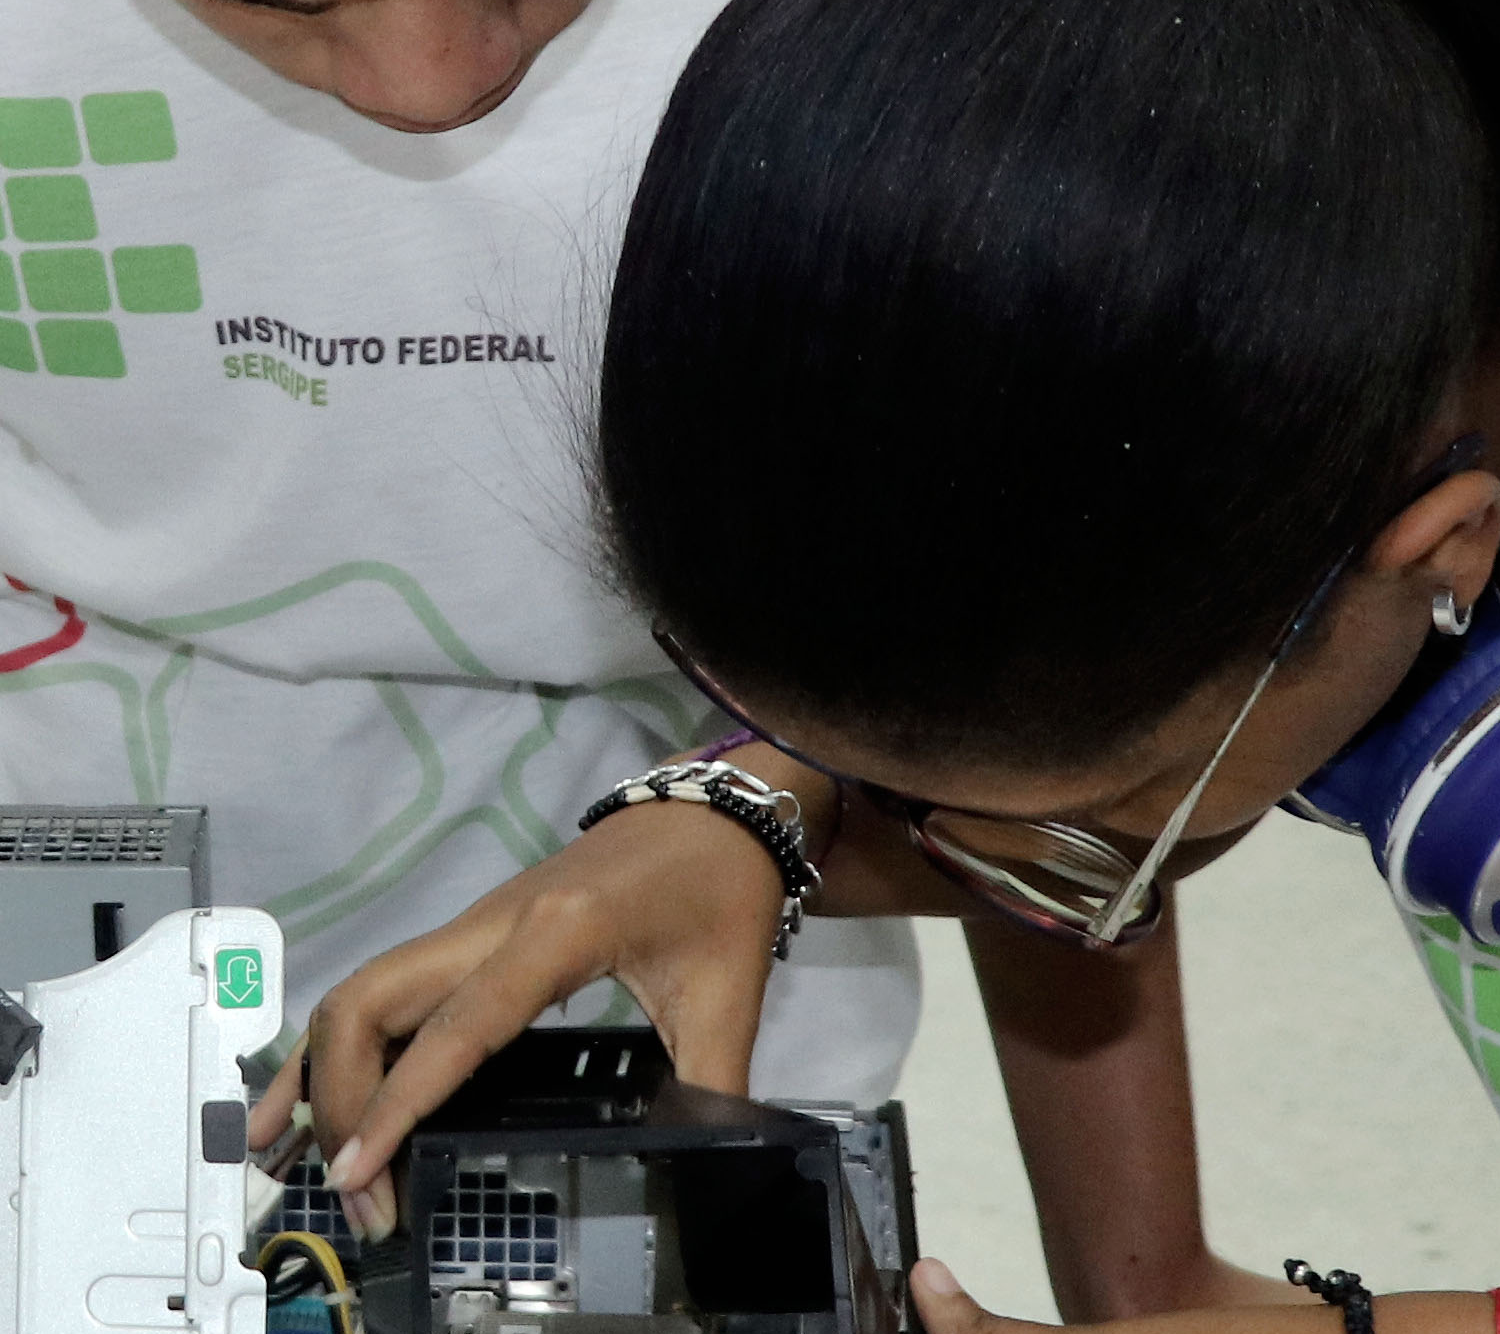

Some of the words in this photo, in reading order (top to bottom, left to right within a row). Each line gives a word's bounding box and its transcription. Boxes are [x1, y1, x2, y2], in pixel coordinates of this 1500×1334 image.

[214, 315, 387, 368] INSTITUTO
[396, 333, 557, 367] FEDERAL
[222, 352, 329, 407] SERGIPE
